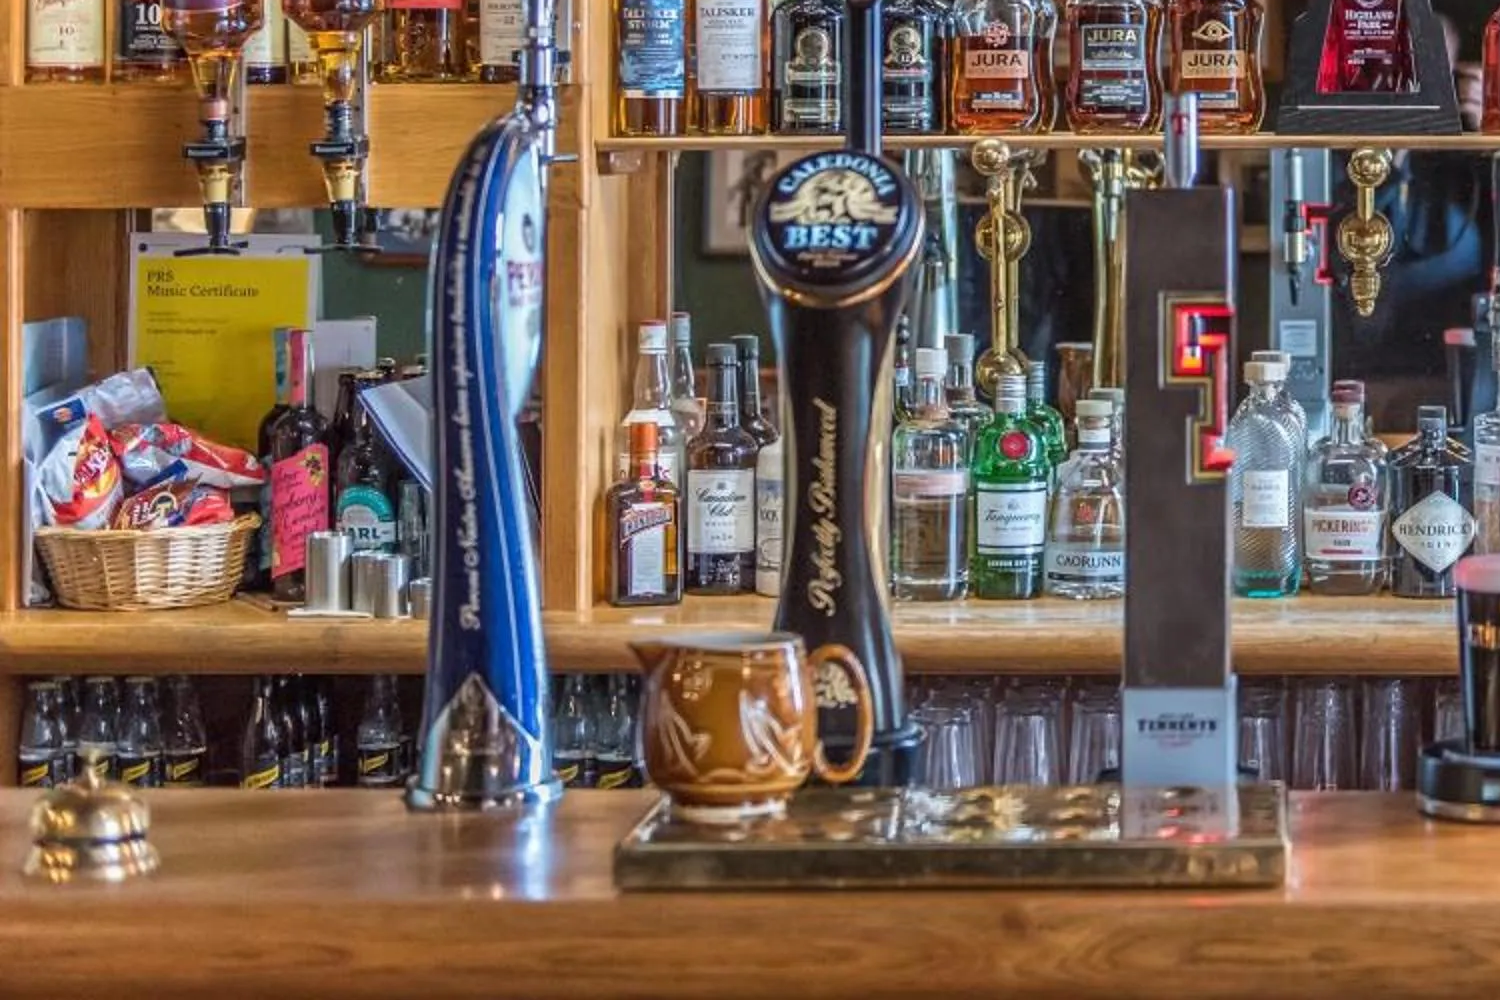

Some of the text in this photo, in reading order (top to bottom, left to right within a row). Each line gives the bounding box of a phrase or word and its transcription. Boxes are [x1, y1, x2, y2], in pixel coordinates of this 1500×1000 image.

[135, 3, 161, 26] 10
[700, 7, 756, 18] TALISKER
[1087, 29, 1137, 42] JURA
[970, 52, 1023, 67] JURA
[1187, 53, 1239, 68] JURA
[777, 153, 897, 197] CALEDONIA
[783, 225, 880, 250] BEST
[146, 271, 174, 283] PRS
[147, 284, 259, 298] Music Certificate
[695, 487, 747, 503] Canadian
[707, 502, 733, 517] Club
[808, 398, 843, 617] Perfectly Balanced
[985, 509, 1041, 526] Tanqueray
[1056, 554, 1121, 568] CAORUNN
